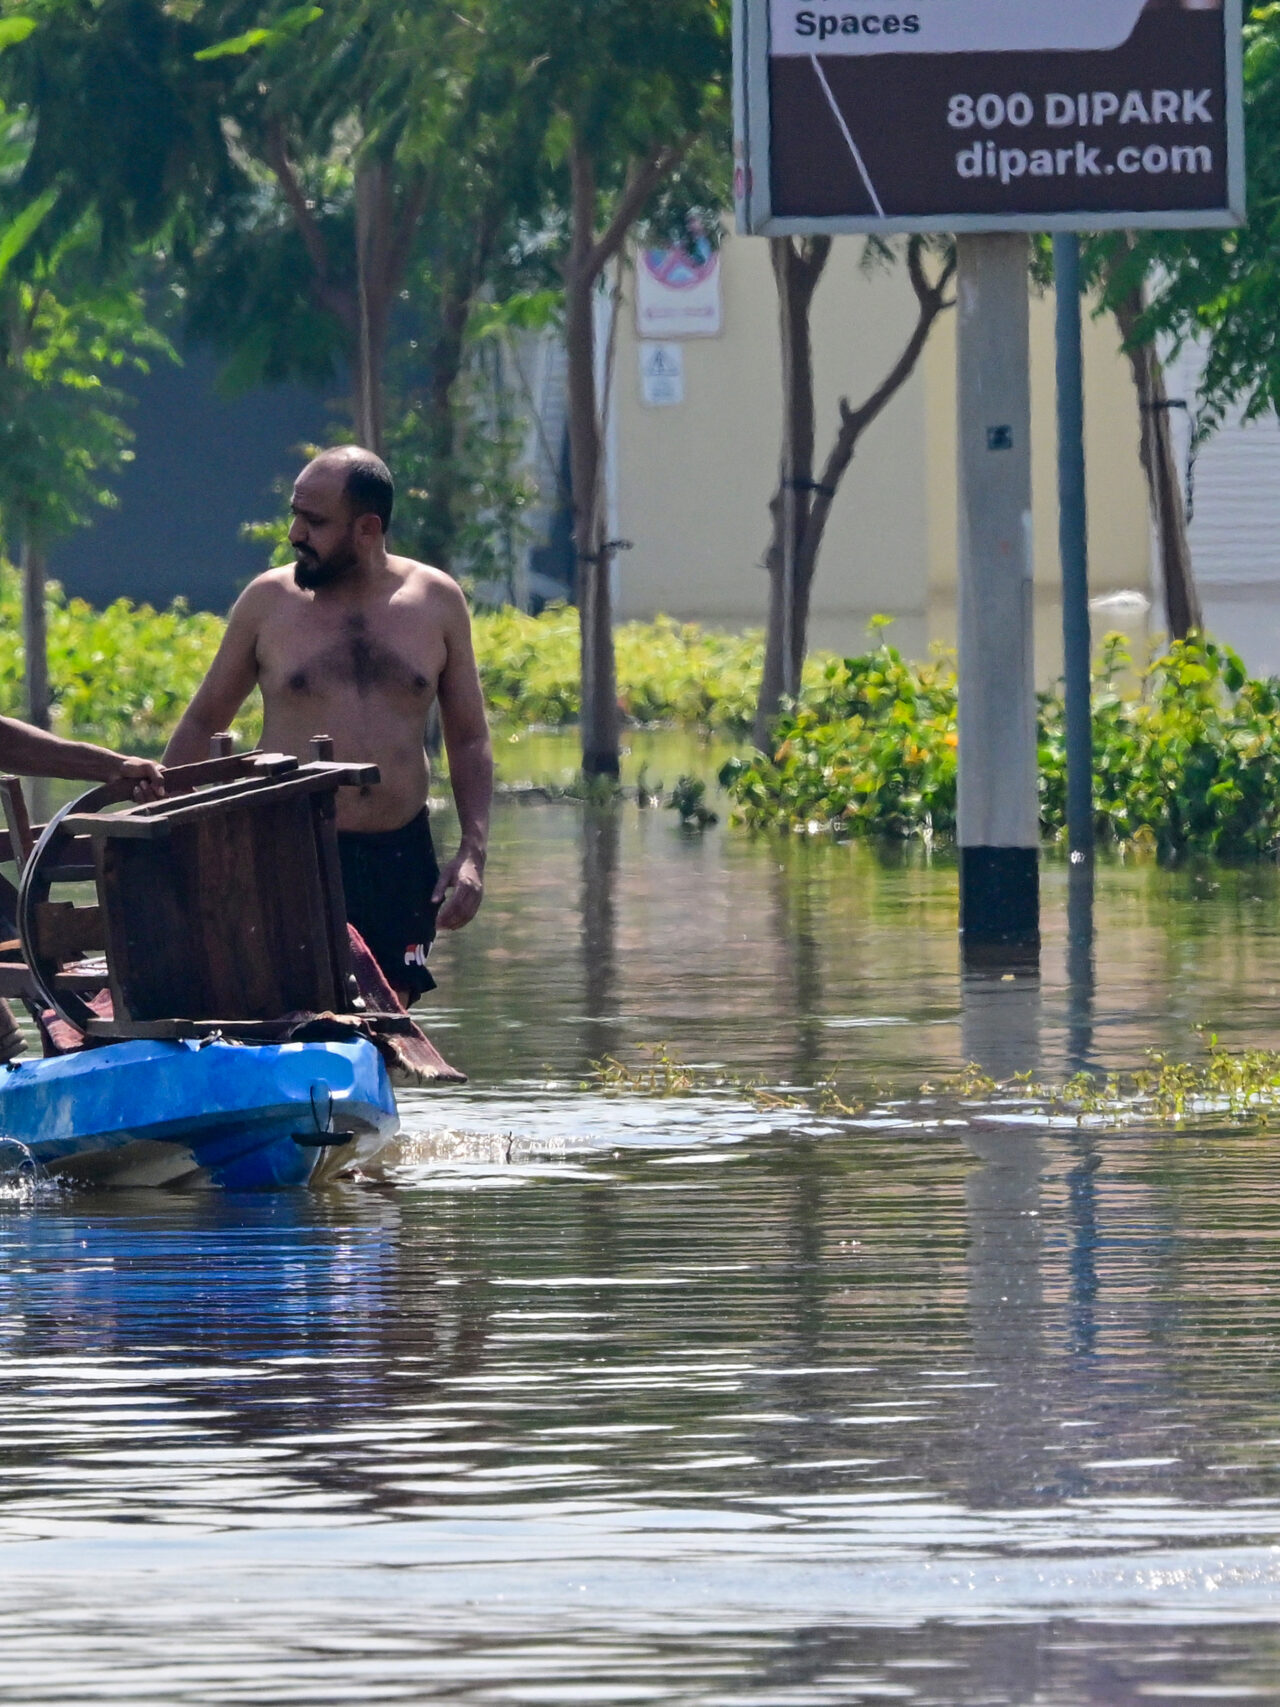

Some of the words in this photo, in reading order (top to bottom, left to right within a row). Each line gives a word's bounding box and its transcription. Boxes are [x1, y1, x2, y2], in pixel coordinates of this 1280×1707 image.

[795, 11, 920, 40] Spaces
[947, 93, 1034, 128] 800
[1045, 89, 1213, 126] DIPARK
[956, 141, 1212, 184] dipark.com
